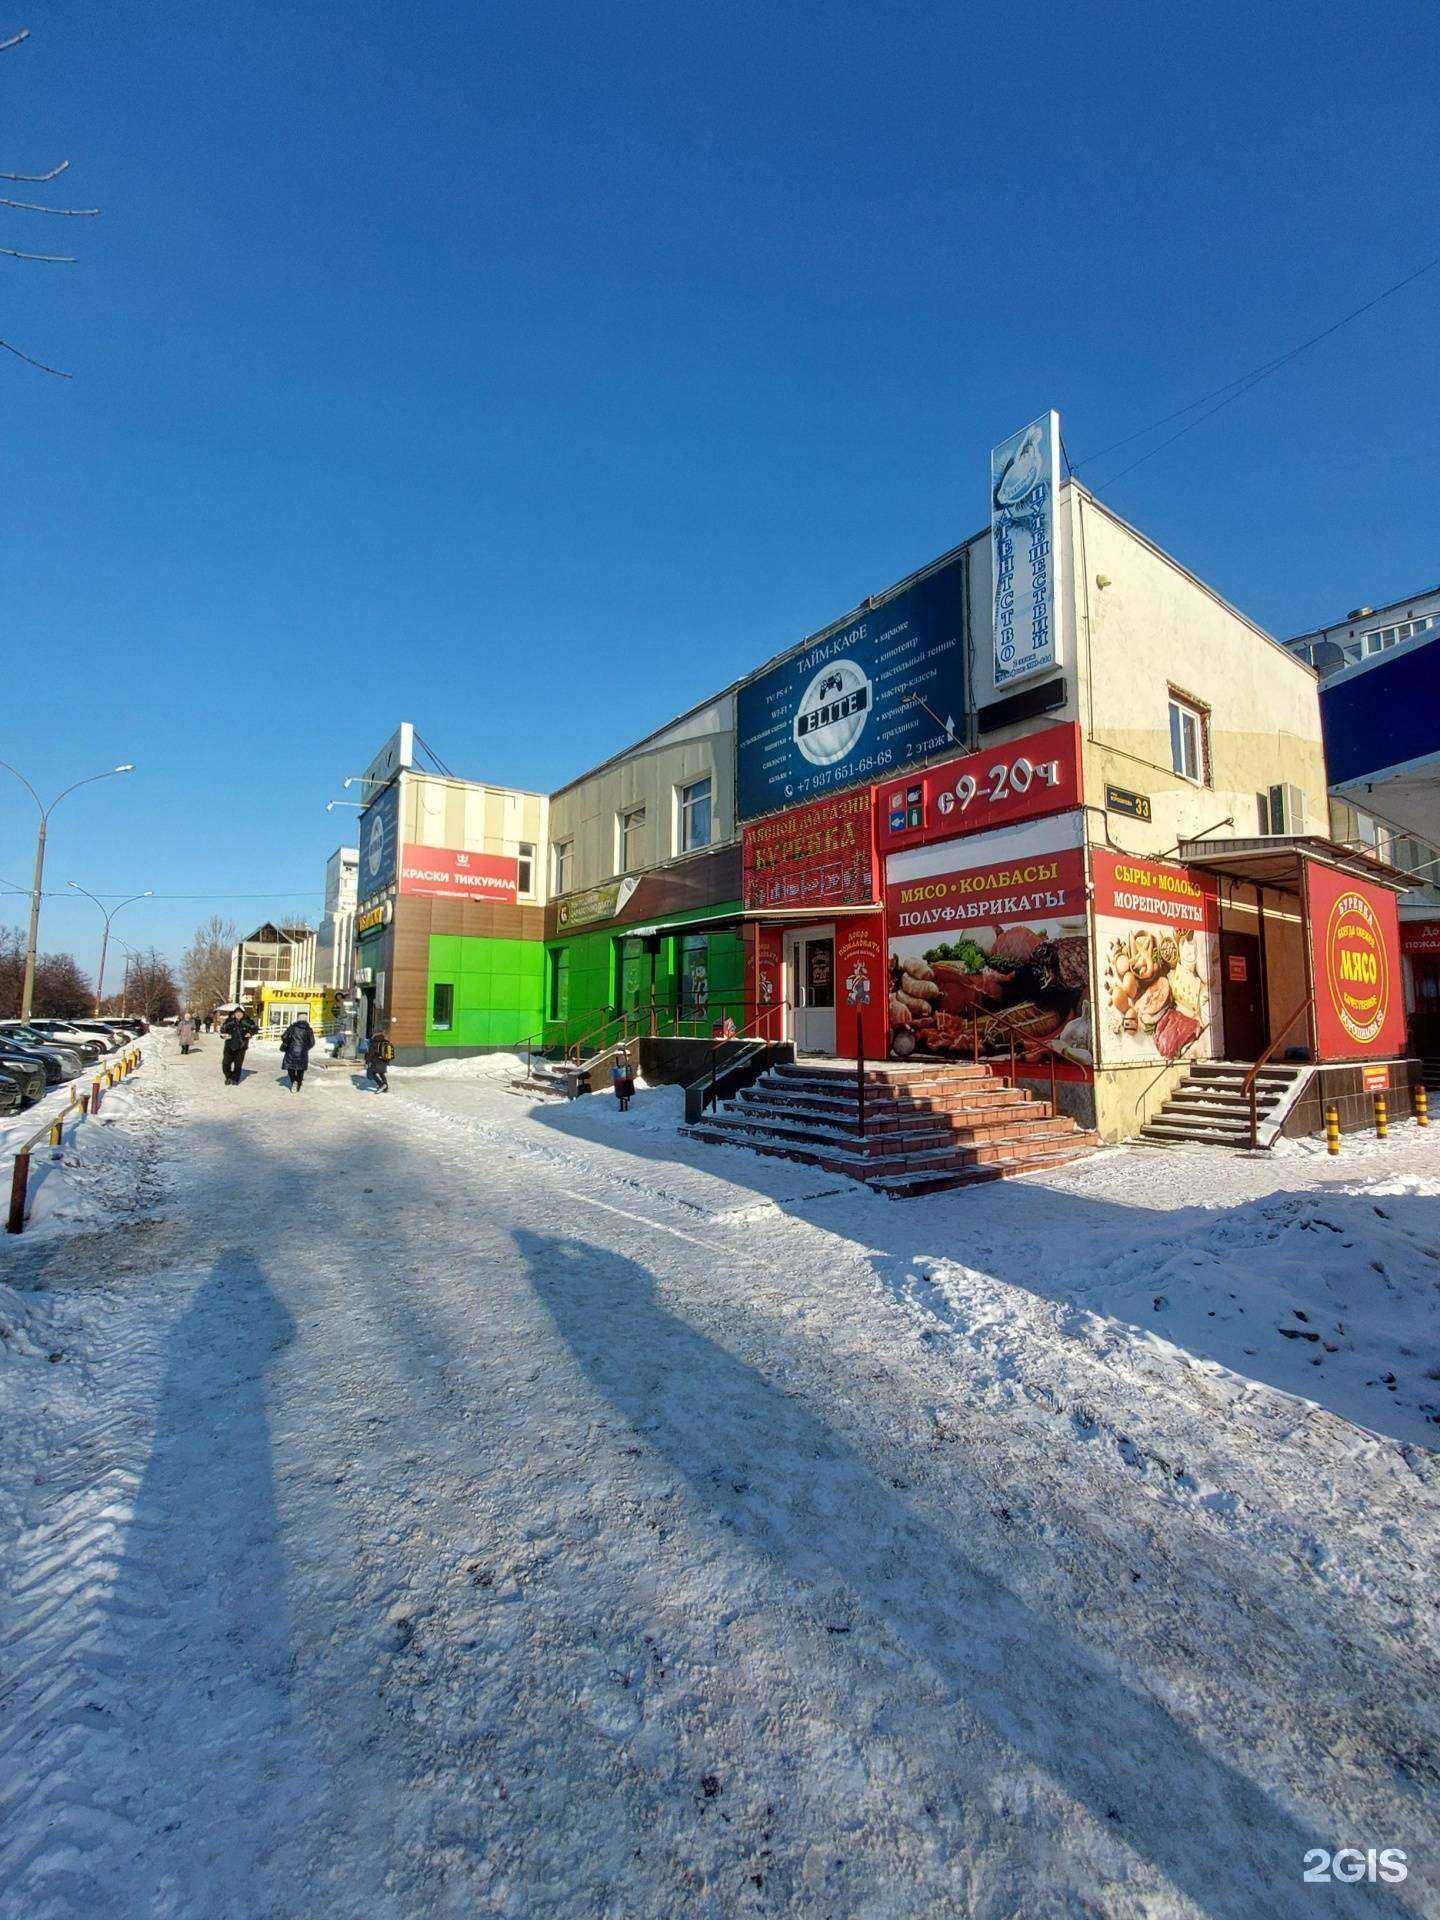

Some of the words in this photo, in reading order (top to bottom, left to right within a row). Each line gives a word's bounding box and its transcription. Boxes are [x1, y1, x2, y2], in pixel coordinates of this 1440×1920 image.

[1000, 503, 1015, 662] АГЕНТСТВО
[1029, 484, 1050, 650] ПУТЕШЕСТВИЙ
[796, 622, 869, 674] ТАЙМ-КАФЕ
[806, 692, 858, 733] ELITE
[812, 770, 832, 789] 937
[834, 748, 893, 782] 651-68-68
[1135, 797, 1150, 818] 33
[402, 868, 450, 883] КРАСКИ
[454, 873, 517, 890] ТИККУРИЛА
[900, 883, 948, 905] МЯСО
[959, 862, 1059, 895] КОЛБАСЫ
[1113, 864, 1151, 887] СЫРЫ
[1158, 874, 1202, 898] МОЛОКО
[898, 889, 1068, 928] ПОЛУФАБРИКАТЫ
[1113, 890, 1203, 922] МОРЕПРОДУКТЫ
[1339, 949, 1378, 985] МЯСО
[272, 989, 327, 999] Пекарня
